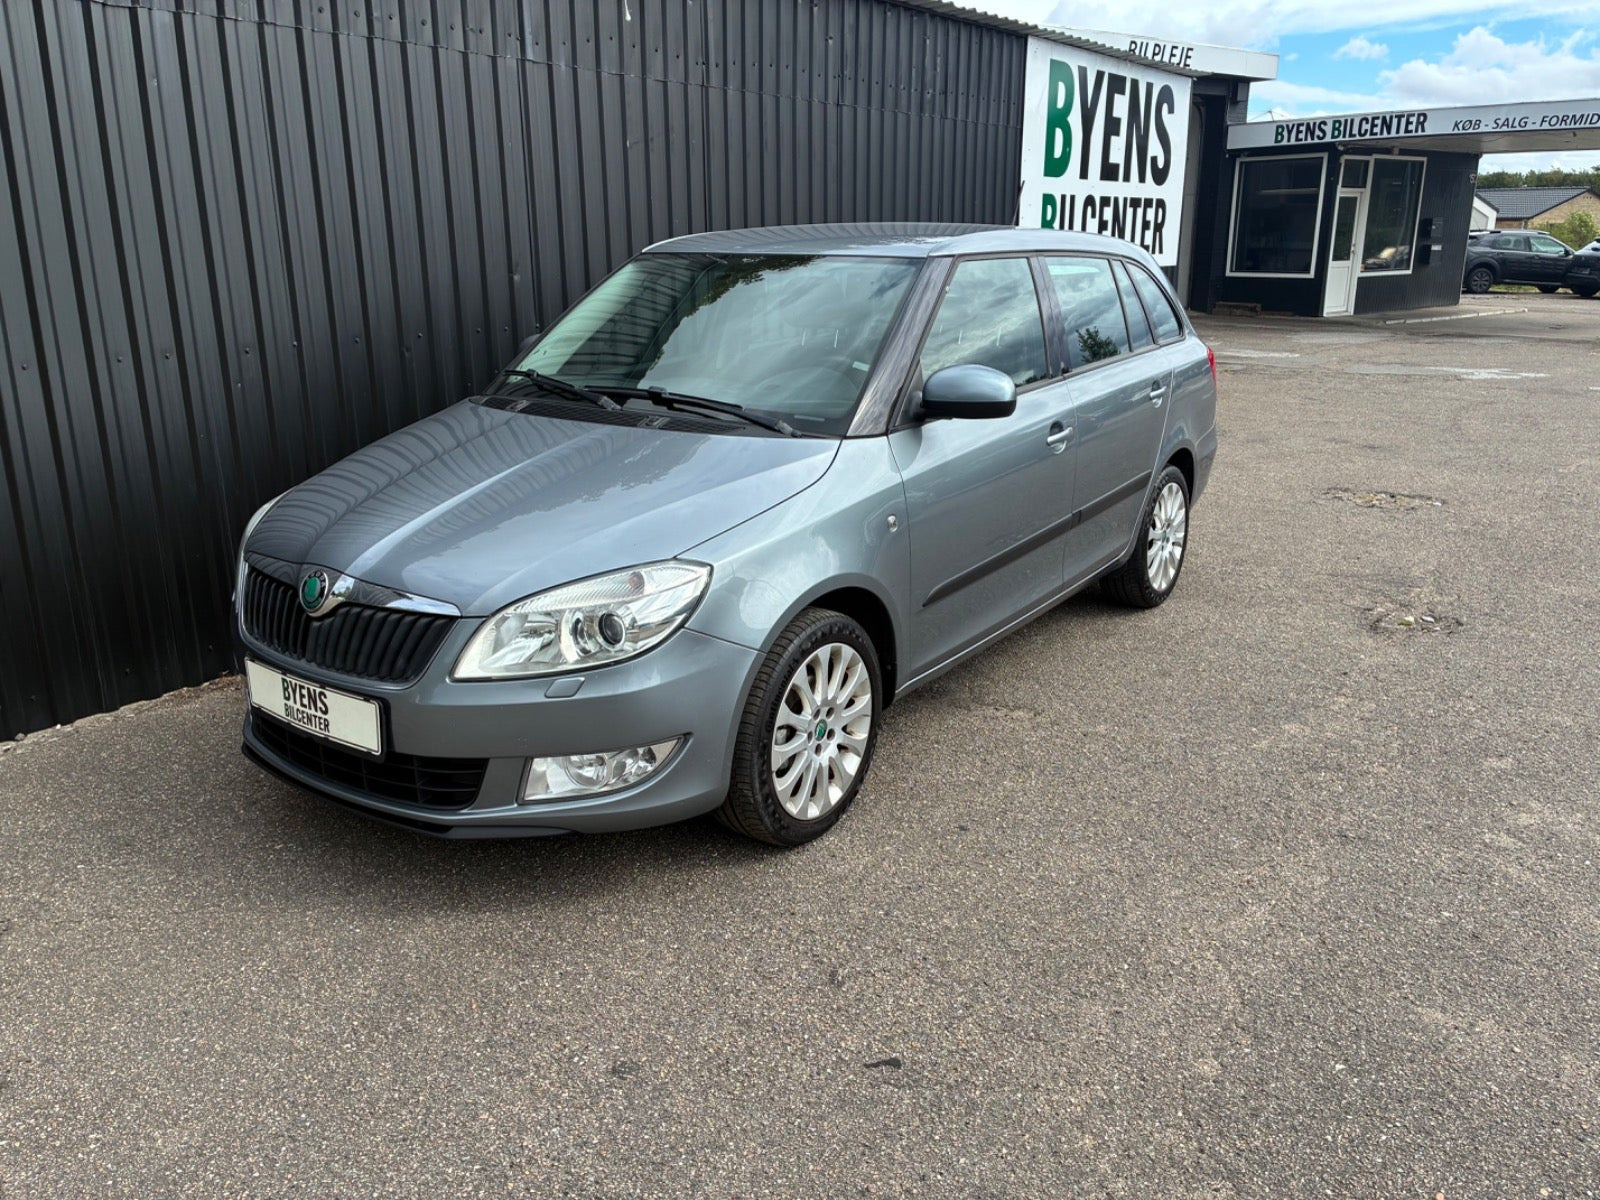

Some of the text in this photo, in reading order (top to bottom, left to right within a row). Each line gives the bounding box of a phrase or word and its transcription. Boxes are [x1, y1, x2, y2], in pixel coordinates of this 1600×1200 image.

[1043, 58, 1175, 186] BYENS
[1274, 112, 1428, 144] BYENS BILCENTER
[1451, 119, 1482, 132] KØB
[1491, 116, 1529, 130] SALG
[1539, 112, 1600, 128] FORMID
[281, 677, 329, 716] BYENS
[284, 702, 330, 733] BILCENTER
